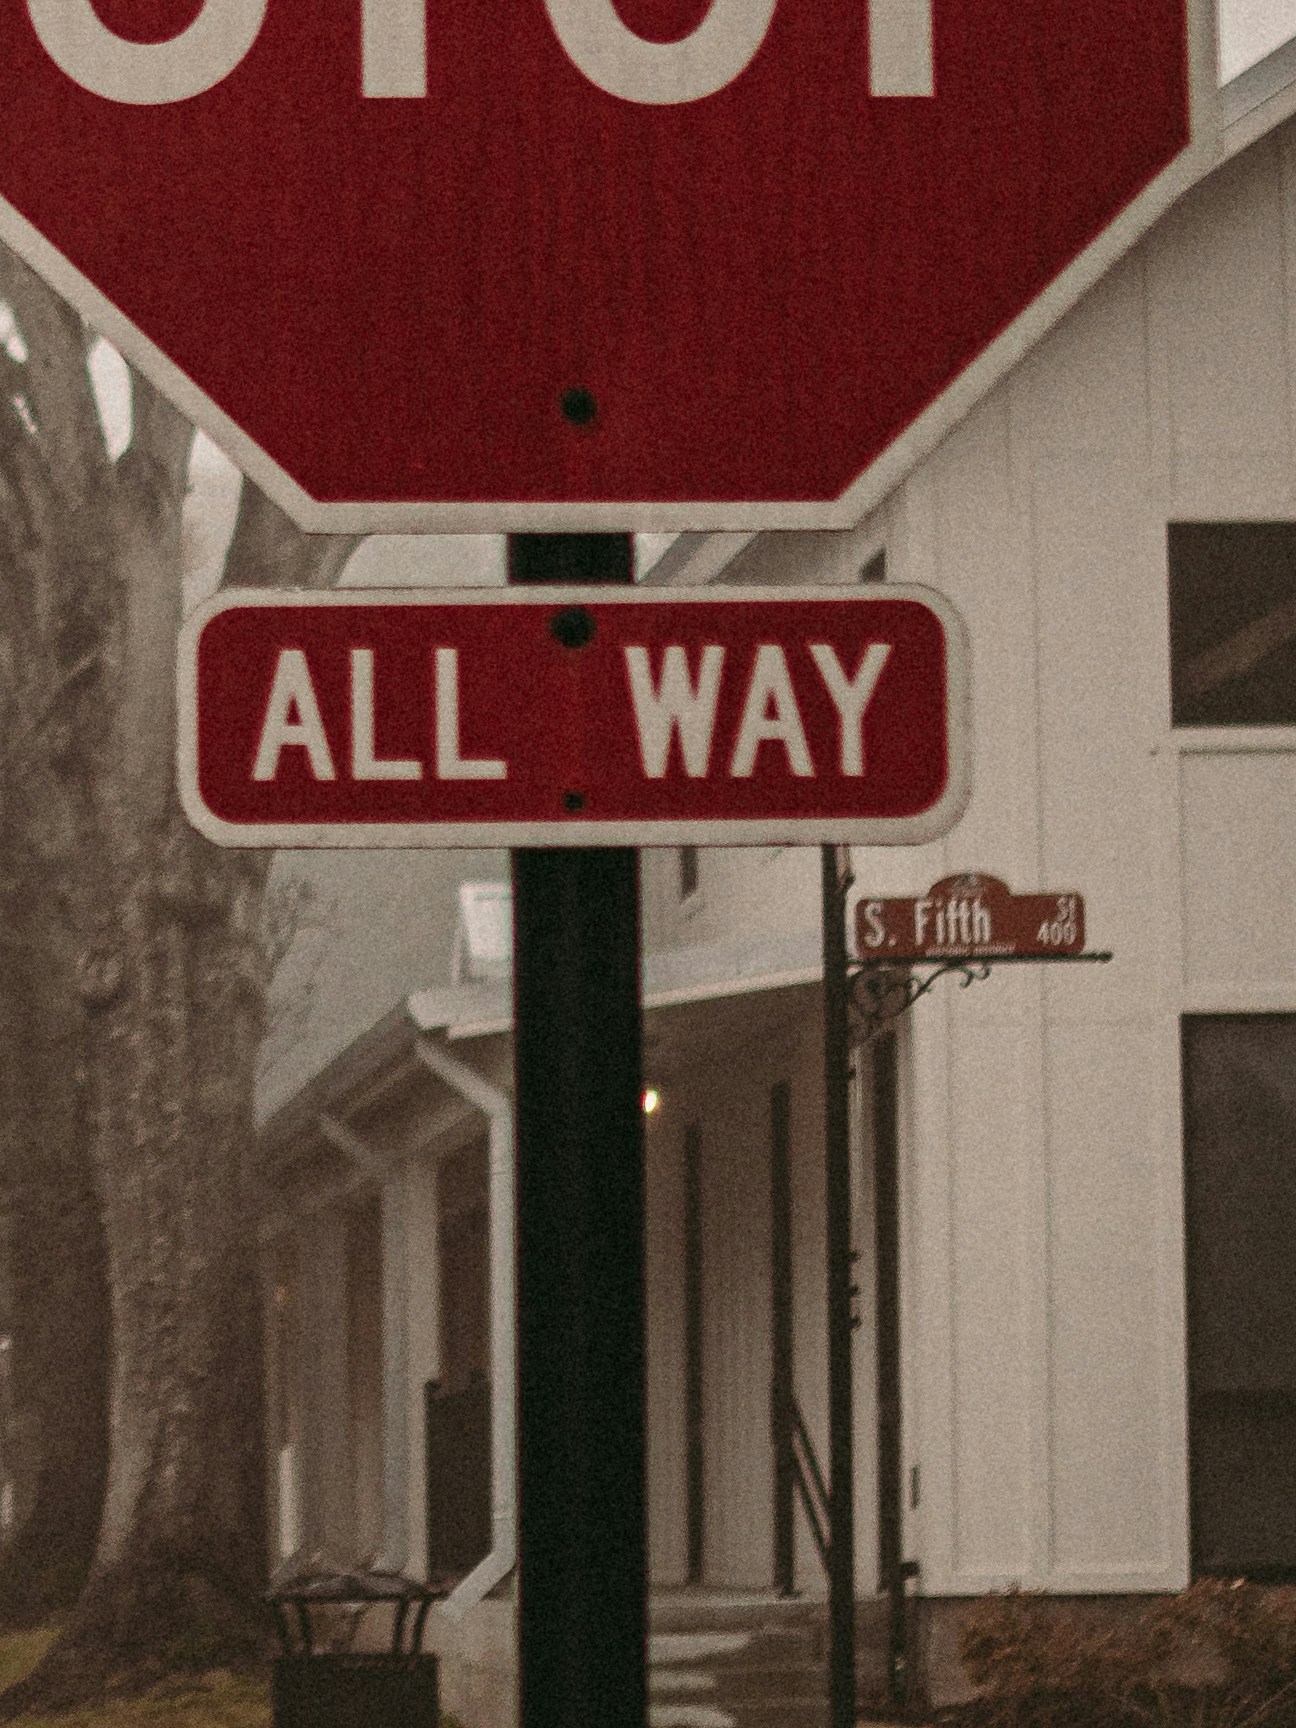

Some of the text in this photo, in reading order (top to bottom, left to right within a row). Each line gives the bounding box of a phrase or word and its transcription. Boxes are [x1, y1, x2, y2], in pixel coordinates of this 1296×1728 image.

[252, 642, 894, 781] ALL WAY
[864, 901, 897, 947] S.
[914, 895, 992, 946] Fifth
[1036, 919, 1077, 946] 400
